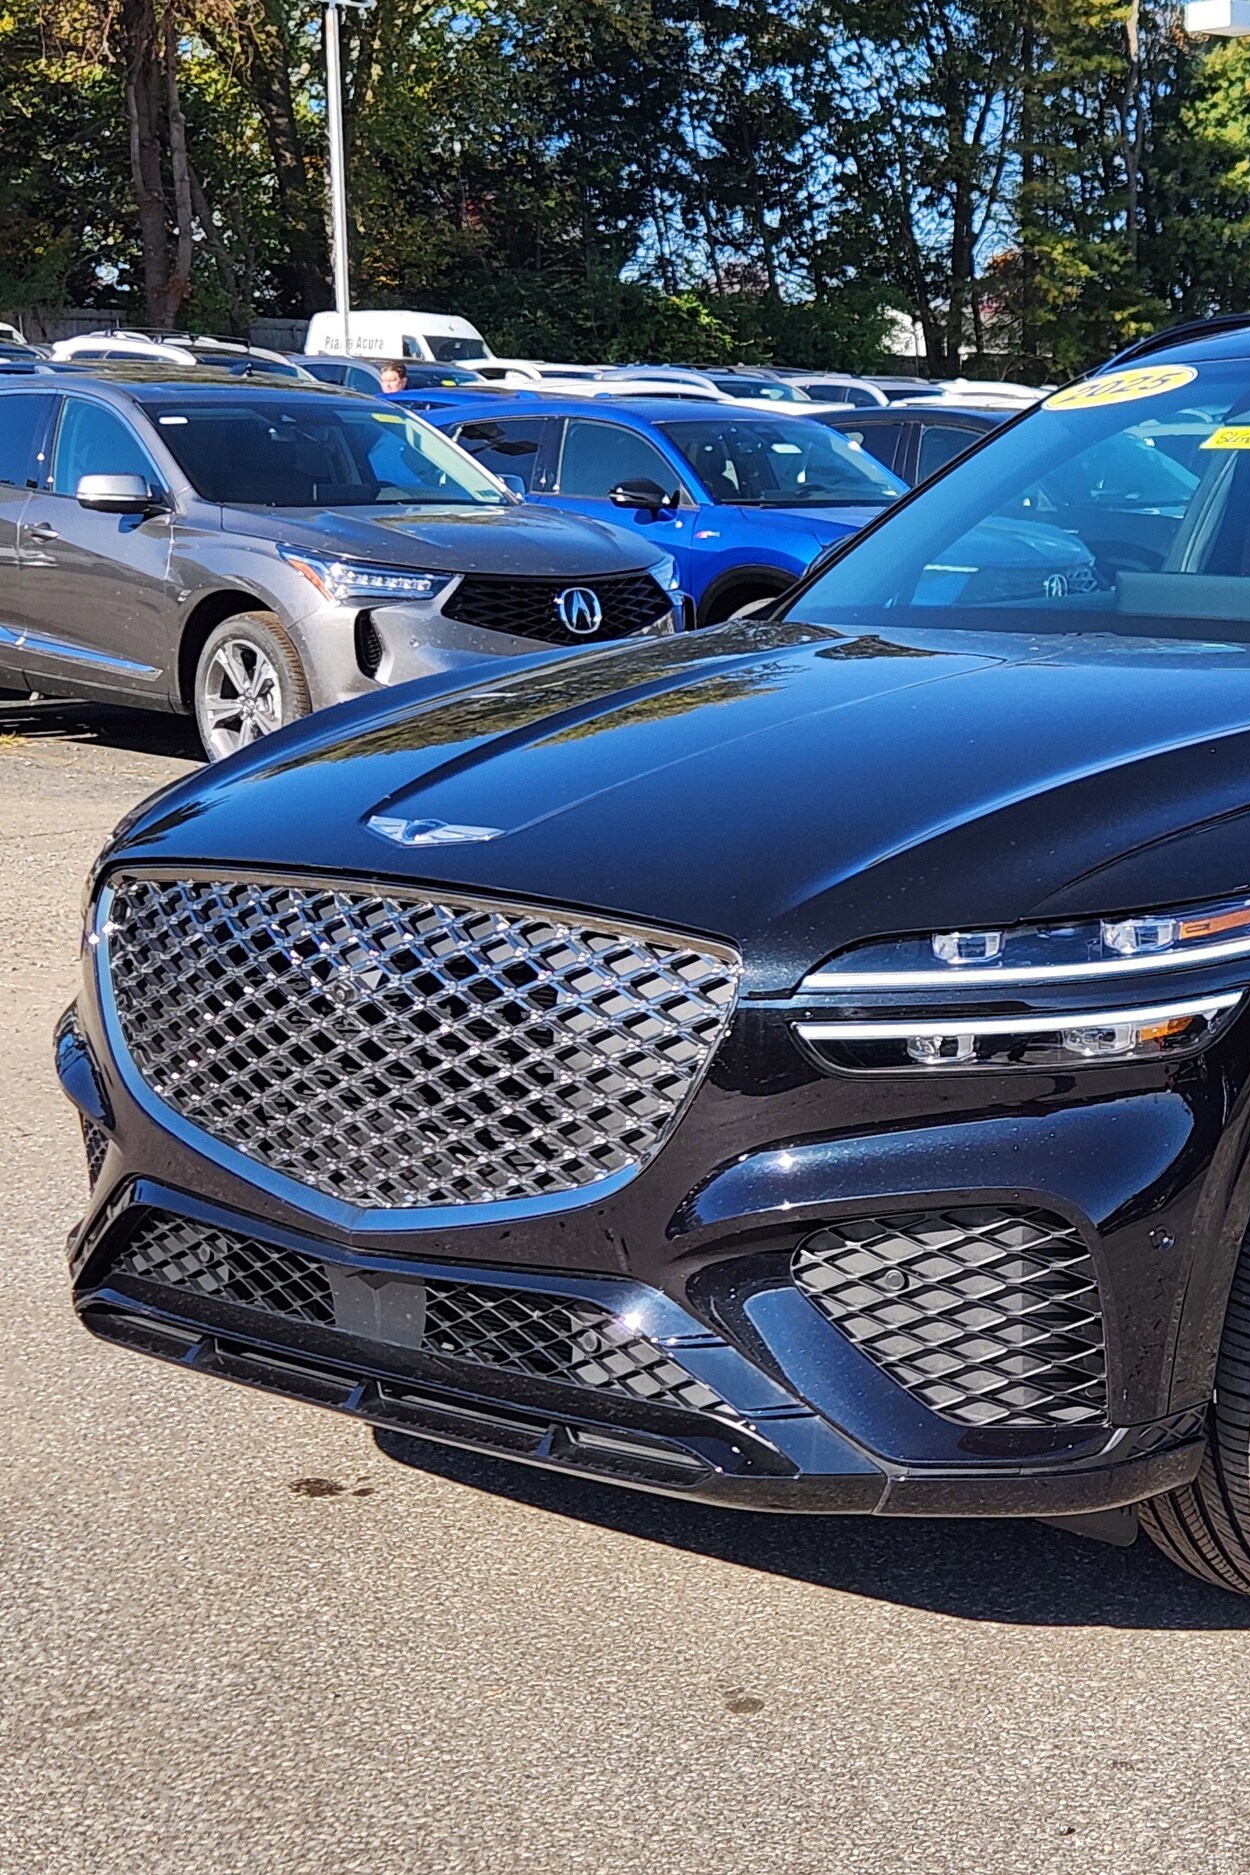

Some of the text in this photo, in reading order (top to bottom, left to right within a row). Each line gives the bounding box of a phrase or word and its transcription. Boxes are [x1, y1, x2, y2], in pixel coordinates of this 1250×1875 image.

[325, 336, 384, 350] Piaa Acura
[1056, 371, 1185, 405] 2025
